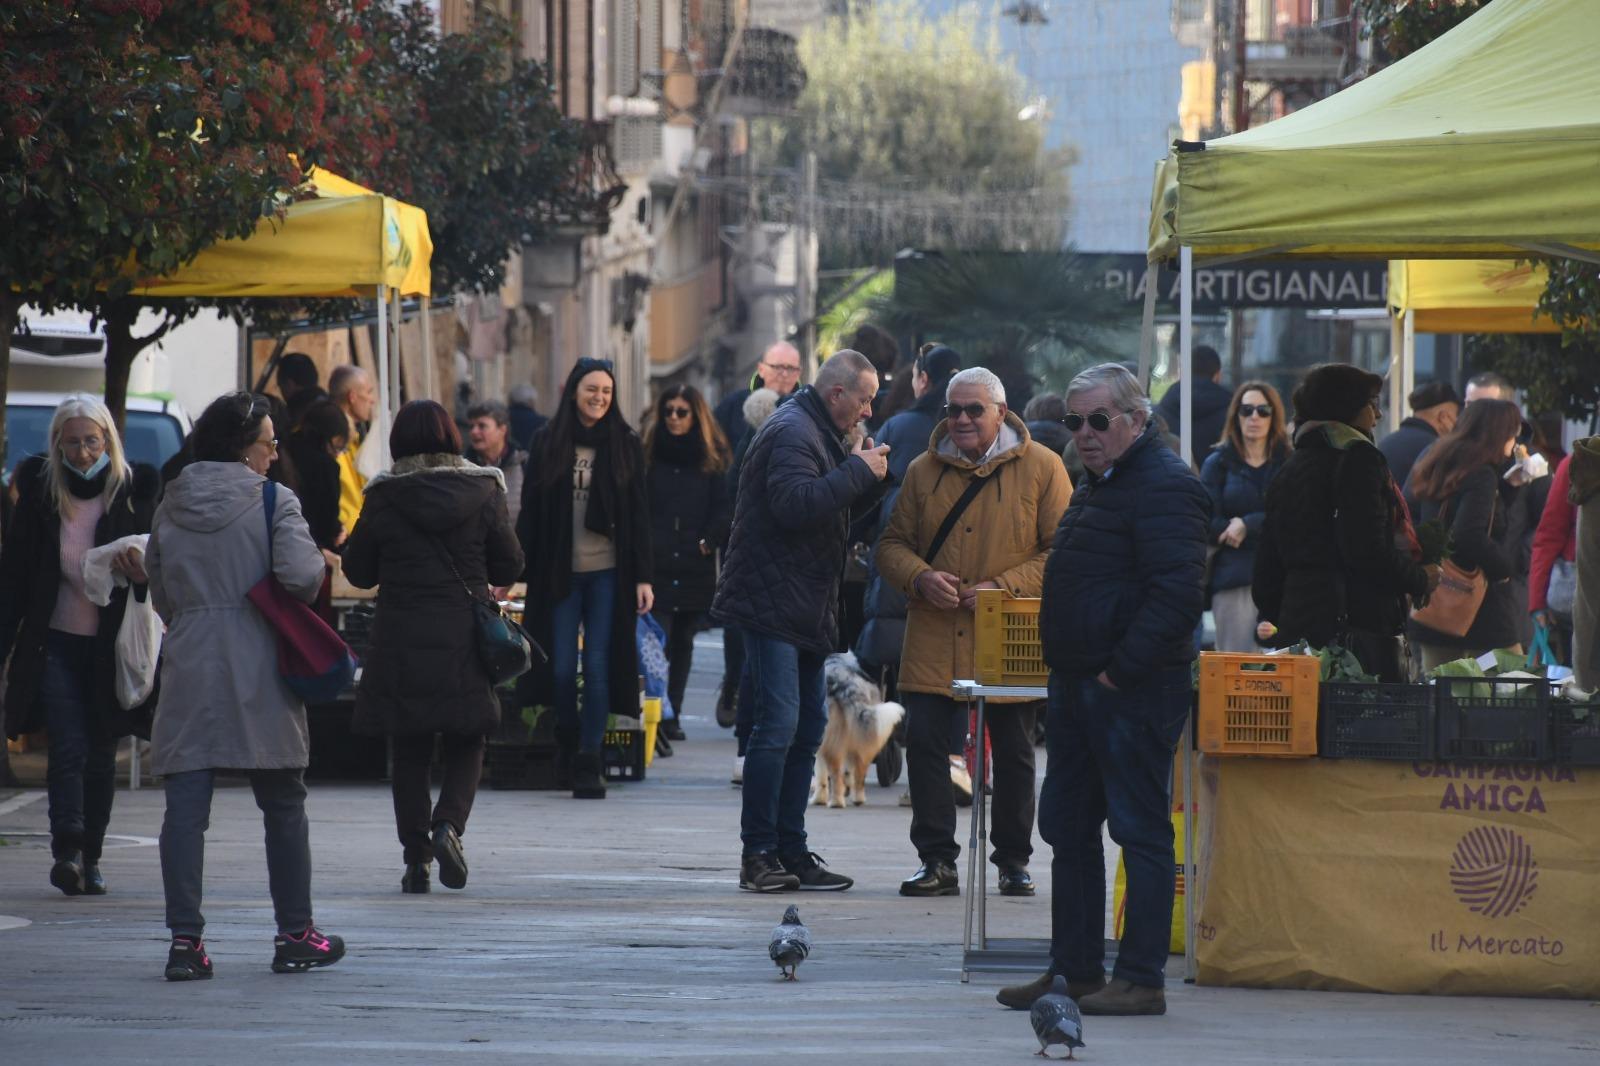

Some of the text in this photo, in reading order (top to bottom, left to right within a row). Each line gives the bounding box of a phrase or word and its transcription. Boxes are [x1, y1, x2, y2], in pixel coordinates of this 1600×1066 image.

[1412, 760, 1576, 783] CAMPAGNA
[1439, 782, 1547, 813] AMICA
[1431, 930, 1564, 957] Il Mercato
